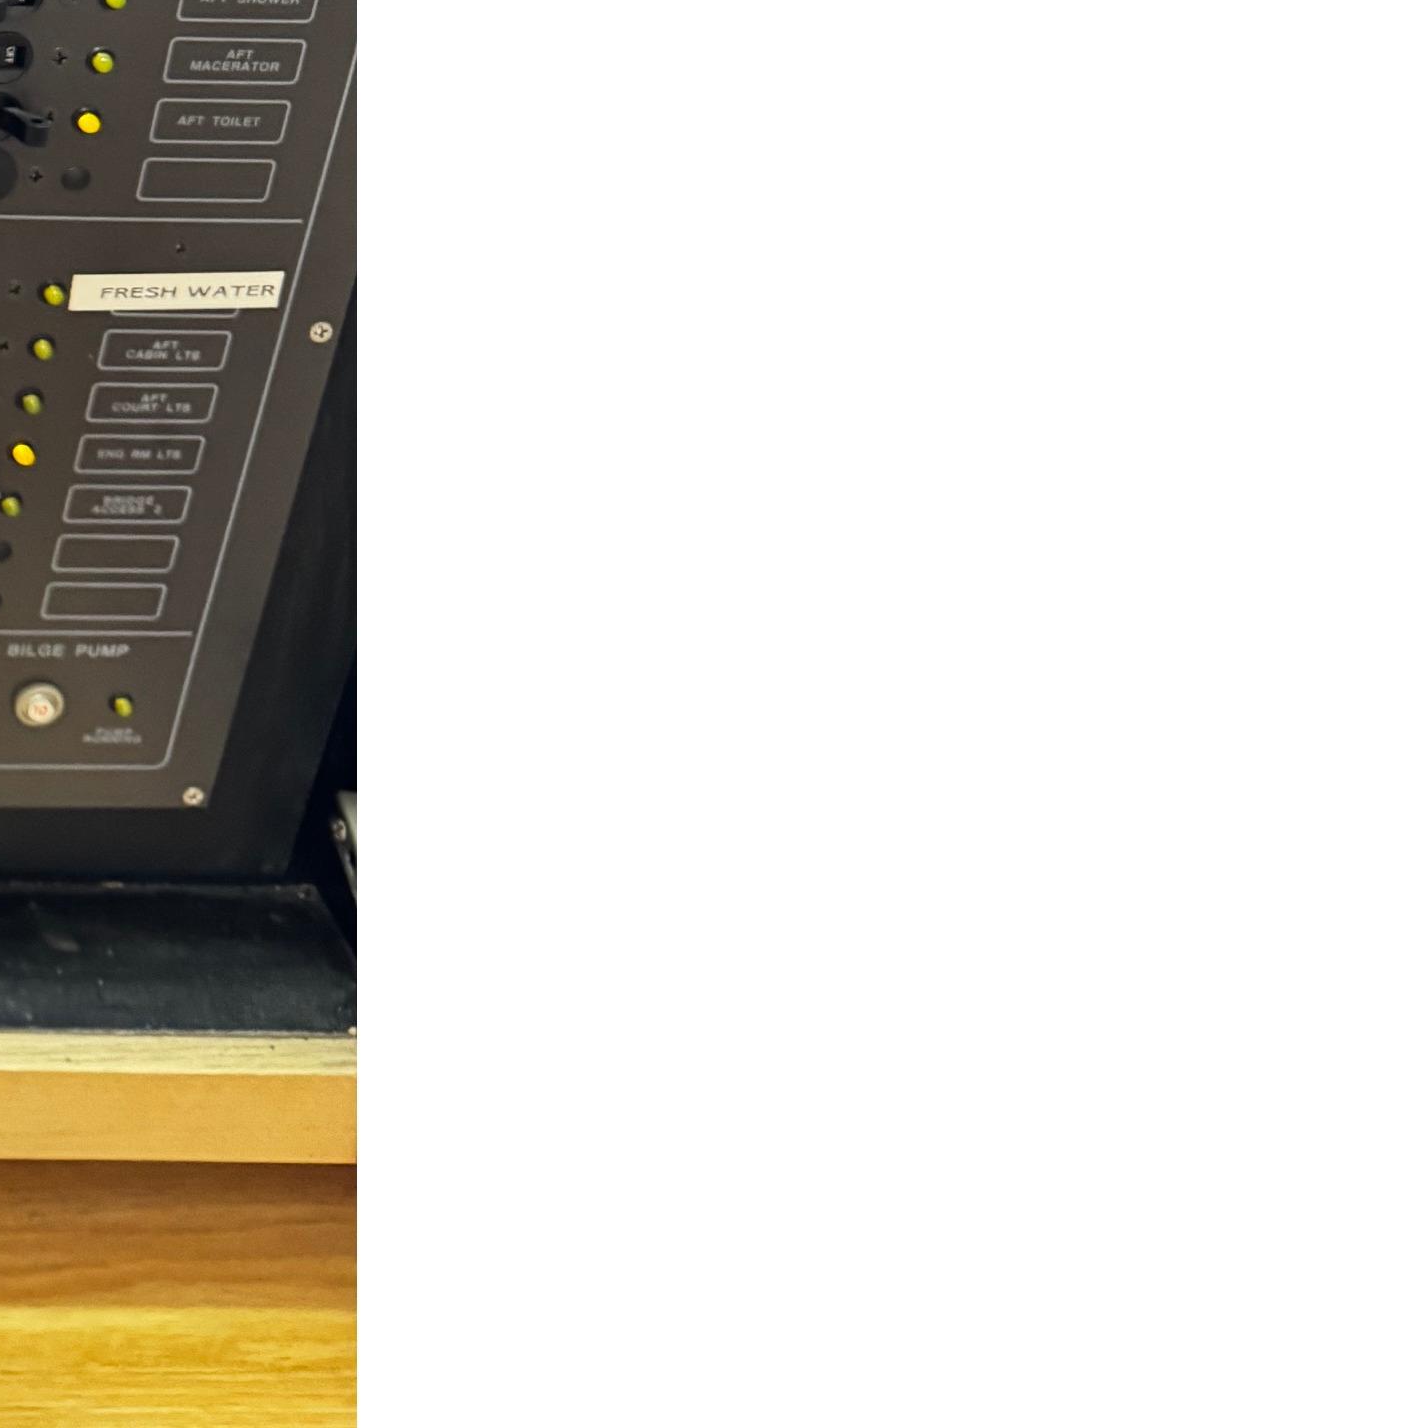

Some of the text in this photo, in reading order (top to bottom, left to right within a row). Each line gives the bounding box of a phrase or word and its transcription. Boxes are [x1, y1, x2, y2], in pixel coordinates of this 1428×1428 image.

[226, 50, 254, 60] AFT
[190, 60, 280, 72] MACERATOR
[178, 115, 261, 127] AFT TOILET
[100, 284, 274, 299] FRESH WATER
[7, 643, 65, 657] BILGE
[75, 644, 130, 657] PUMP
